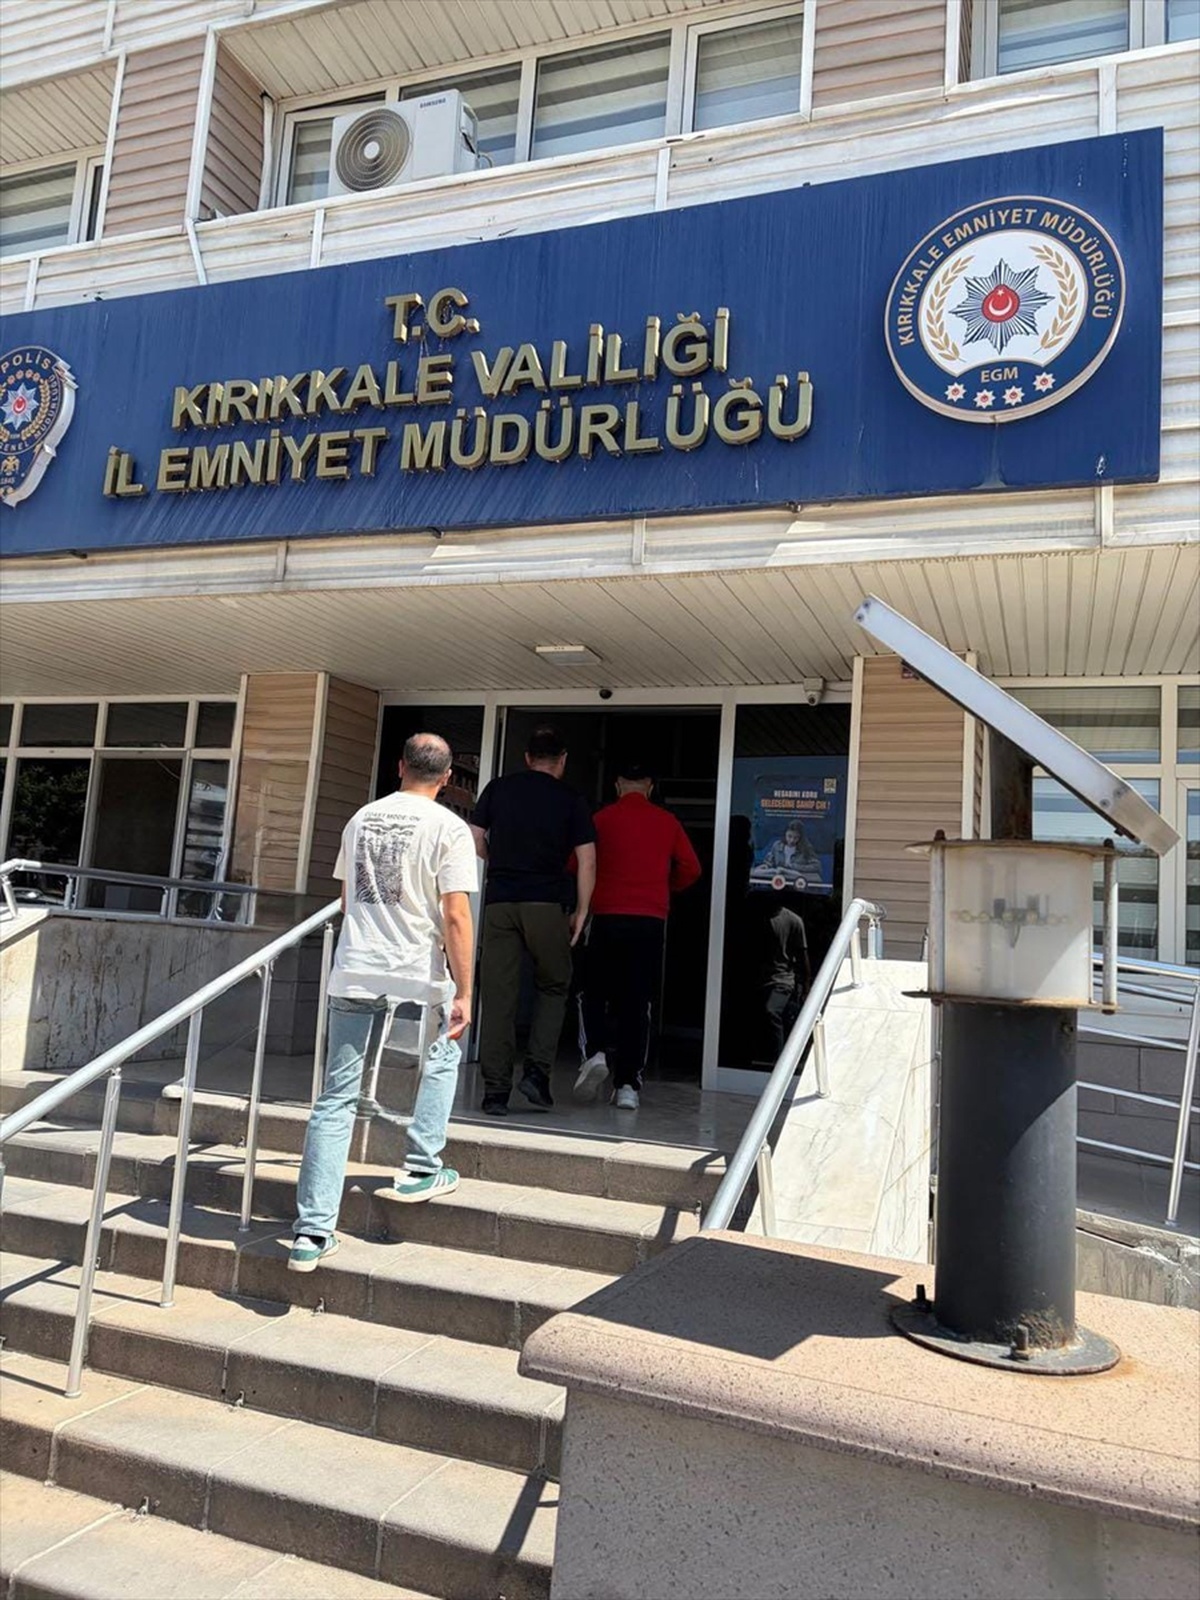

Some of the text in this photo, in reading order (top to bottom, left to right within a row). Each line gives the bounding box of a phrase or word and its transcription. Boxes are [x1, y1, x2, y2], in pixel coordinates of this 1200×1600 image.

[420, 97, 446, 108] SAMSUNG
[897, 208, 1116, 346] KIRIKKALE EMNİYET MÜDÜRLÜĞÜ
[384, 287, 480, 343] T.C.
[0, 350, 52, 374] POLİS
[171, 306, 730, 430] KIRIKKALE VALİLİĞİ
[980, 366, 1019, 383] EGM
[103, 371, 814, 497] İL EMNİYET MÜDÜRLÜĞÜ
